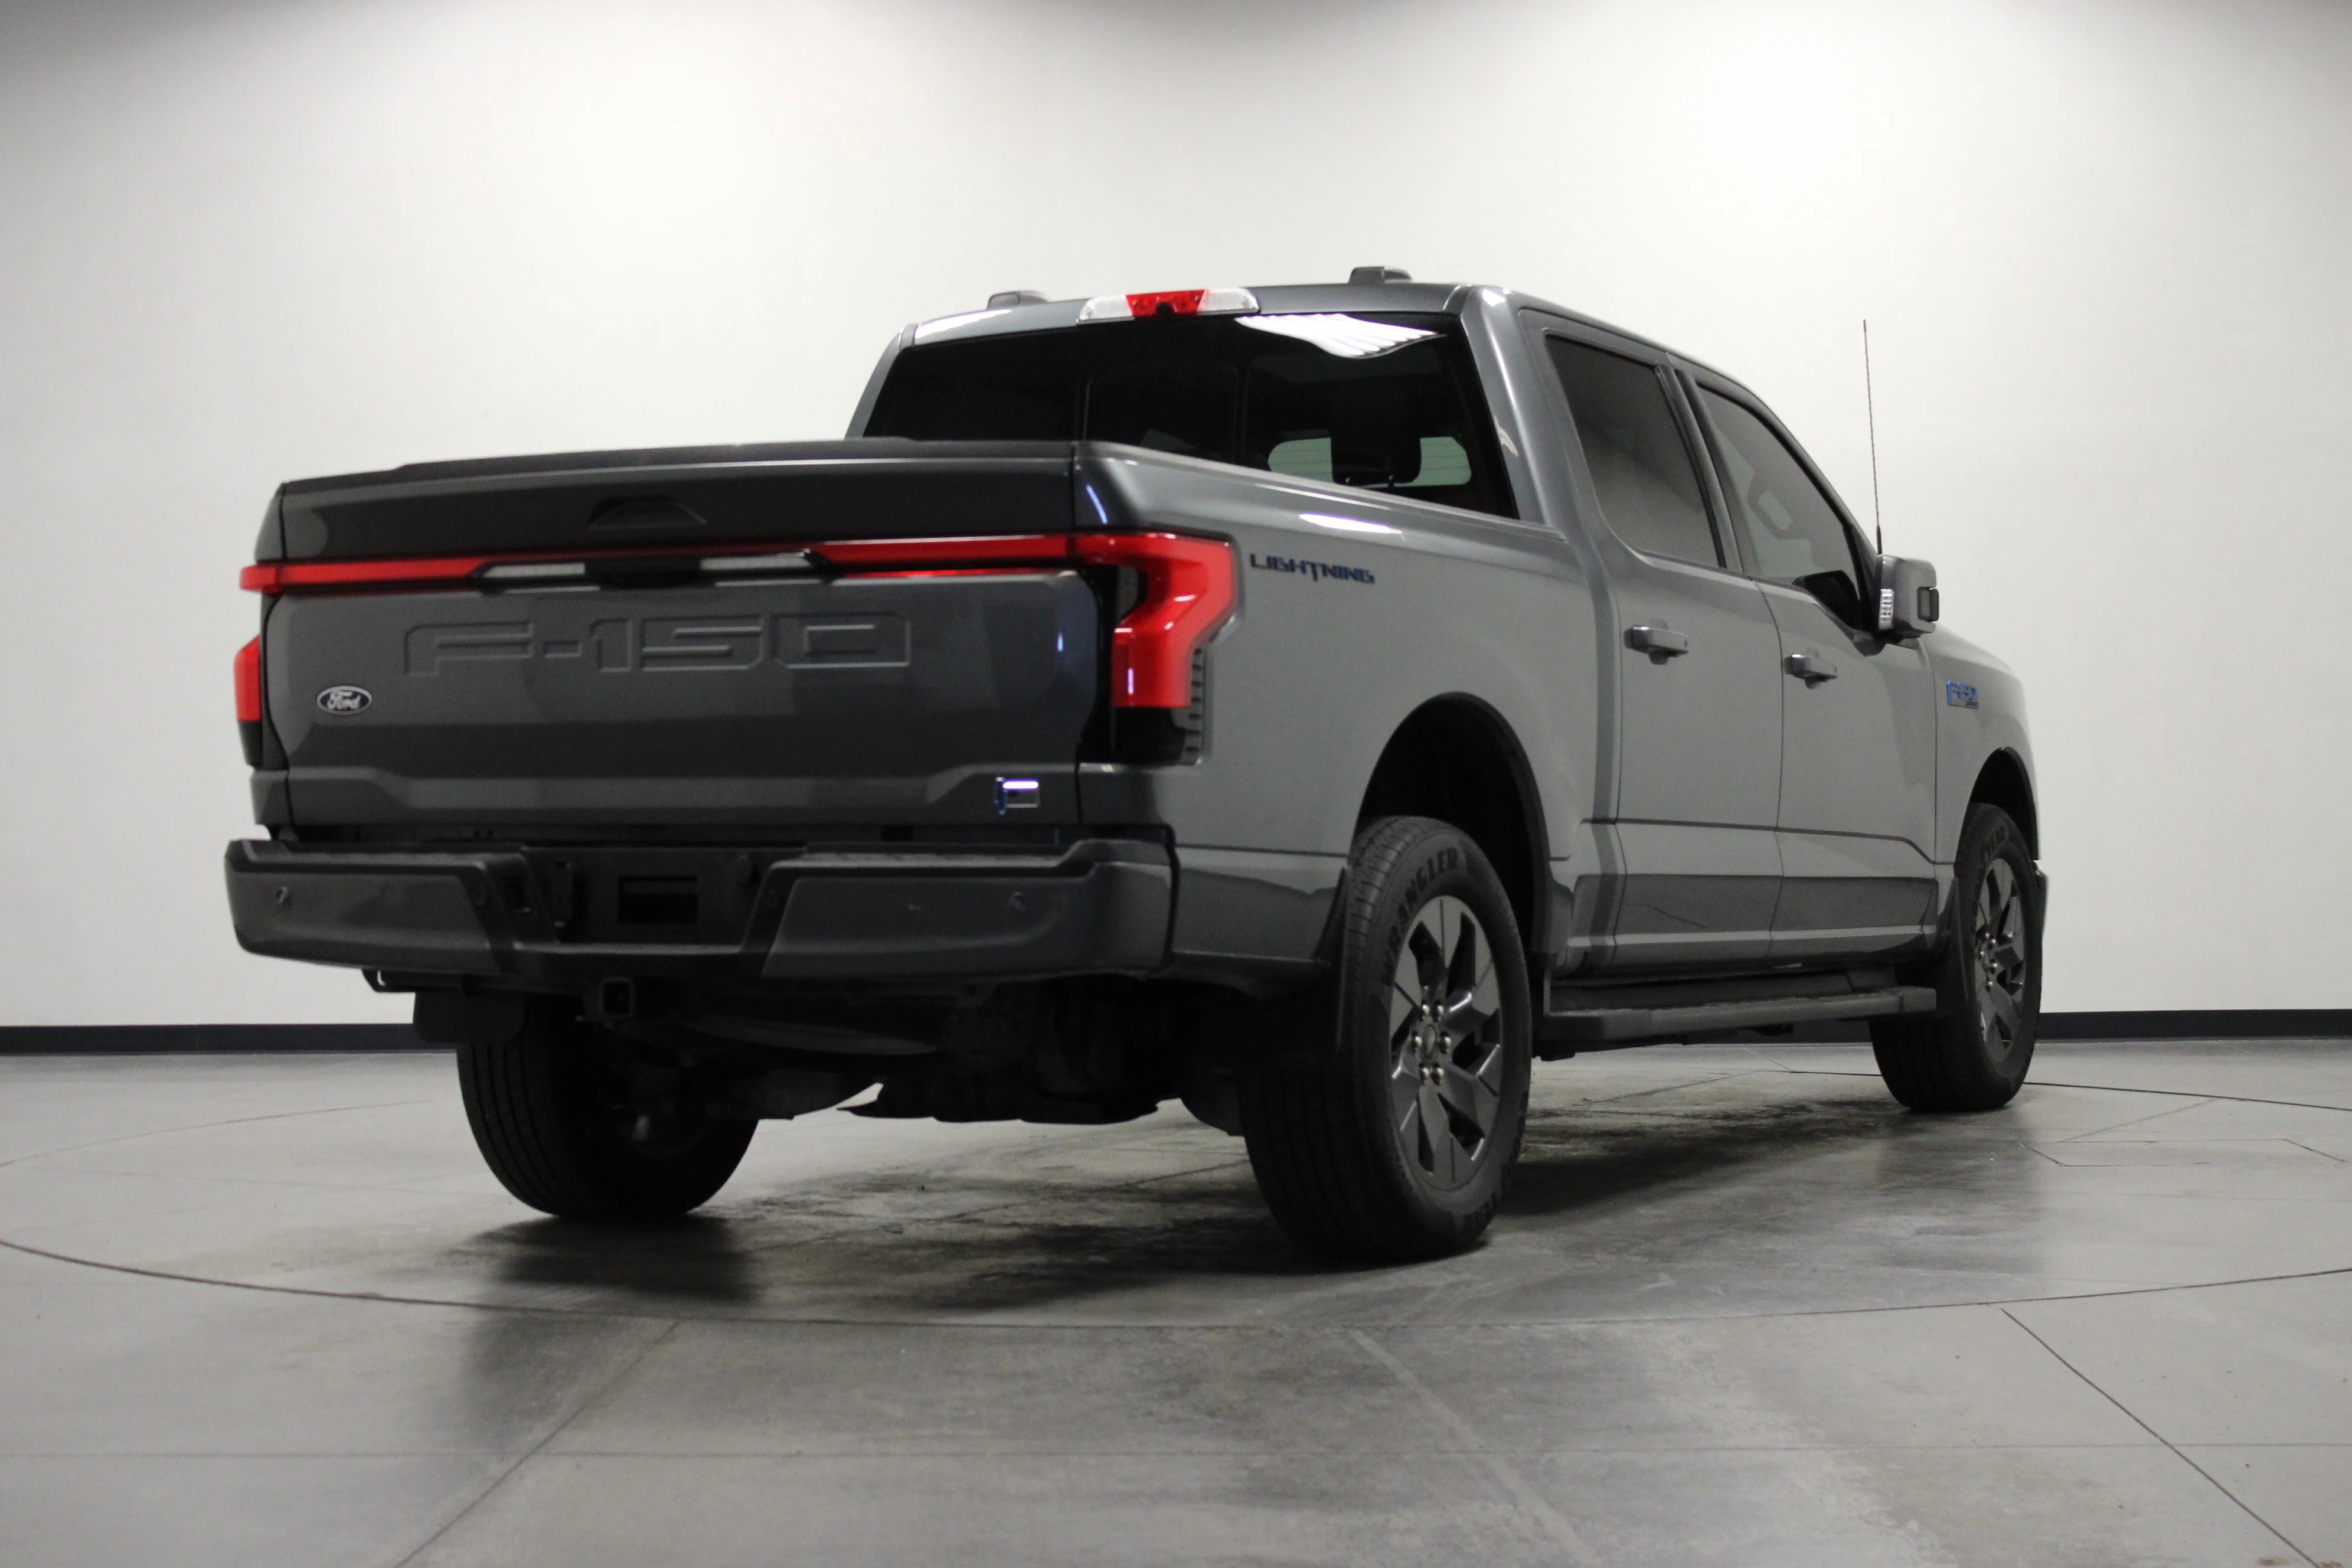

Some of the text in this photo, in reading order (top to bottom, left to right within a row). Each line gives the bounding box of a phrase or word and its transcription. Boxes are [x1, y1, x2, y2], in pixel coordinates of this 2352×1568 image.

[1249, 553, 1375, 584] LIGHTNING
[404, 612, 912, 675] F-150
[326, 690, 362, 710] Ford
